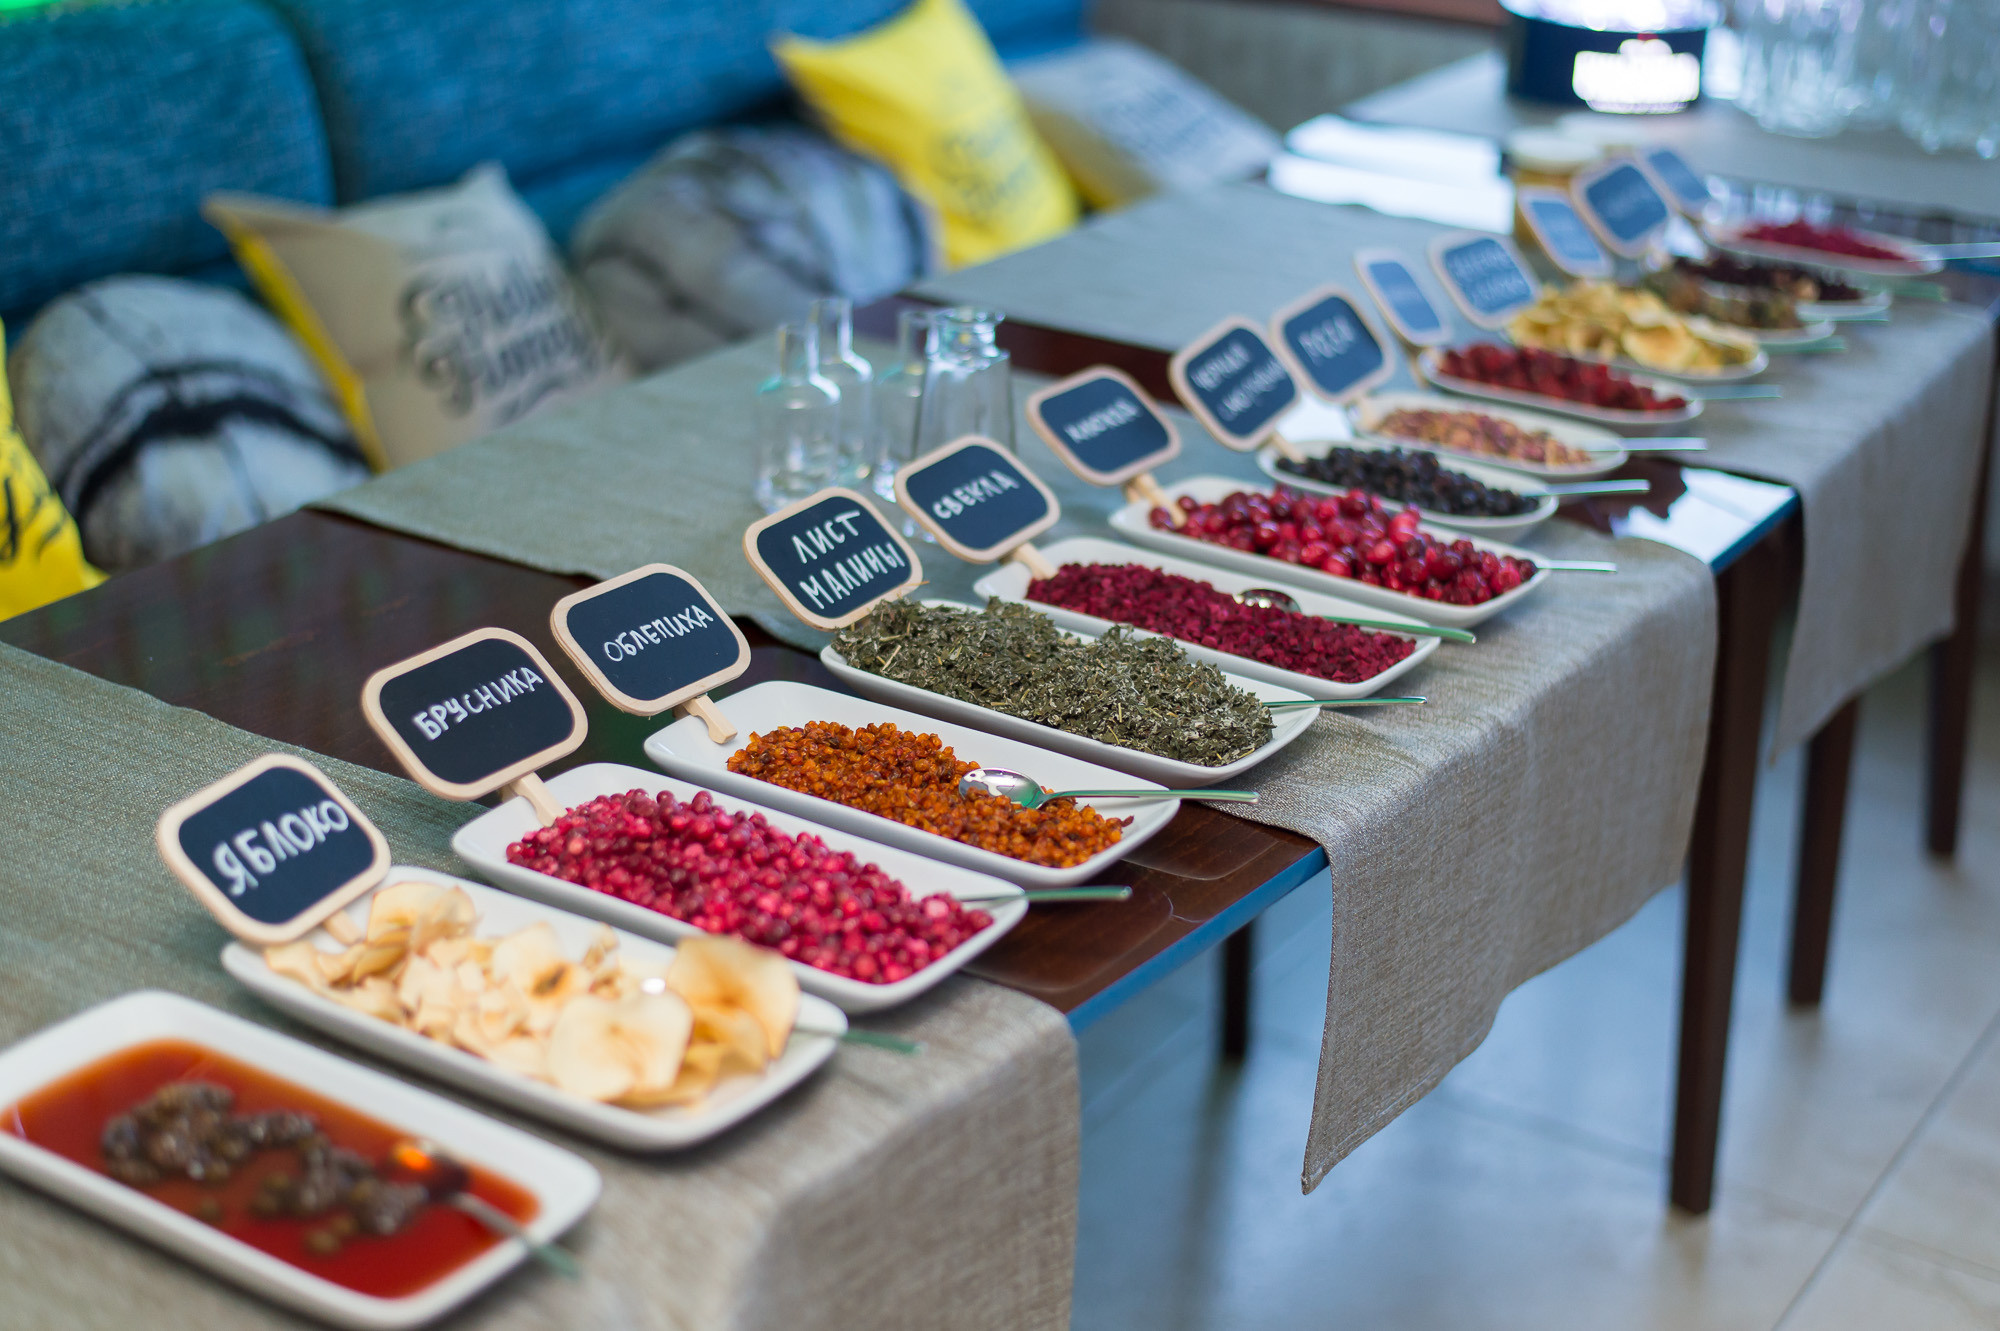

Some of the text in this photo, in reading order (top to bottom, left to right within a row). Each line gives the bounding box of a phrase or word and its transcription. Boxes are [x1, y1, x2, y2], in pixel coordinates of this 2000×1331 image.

[932, 470, 1019, 519] СВЕКЛА
[792, 511, 860, 564] ЛИСТ
[799, 543, 905, 609] МАЛИНЫ
[604, 604, 713, 662] ОБЛЕПИХА
[412, 666, 543, 740] БРУСНИКА
[212, 800, 348, 896] ЯБЛОКО
